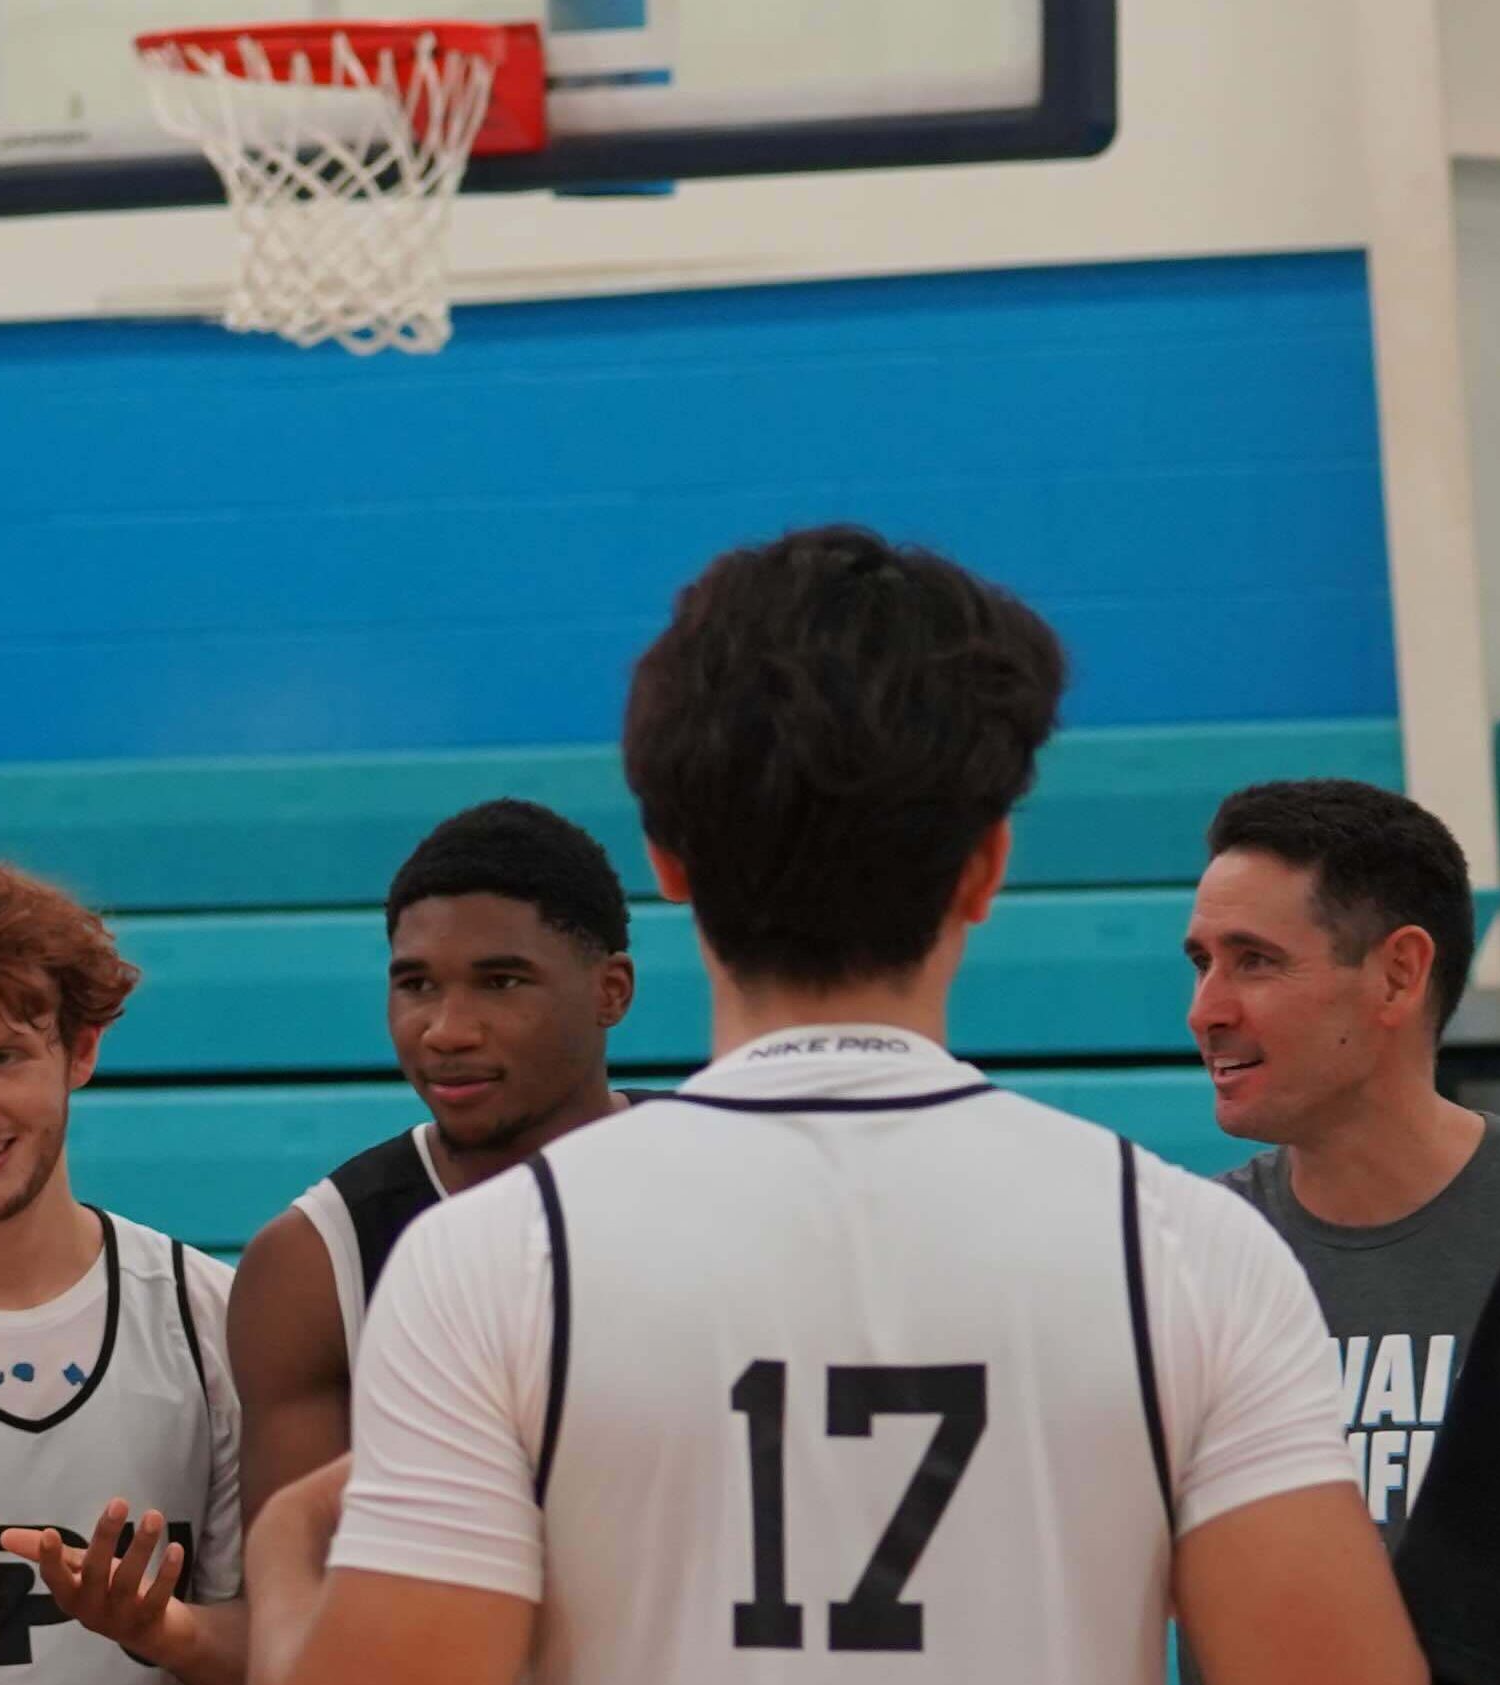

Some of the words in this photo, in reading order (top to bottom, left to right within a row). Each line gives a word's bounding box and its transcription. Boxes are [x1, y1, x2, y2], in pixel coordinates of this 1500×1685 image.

[747, 1037, 829, 1060] NIKE
[836, 1035, 911, 1054] PRO
[730, 1359, 988, 1653] 17
